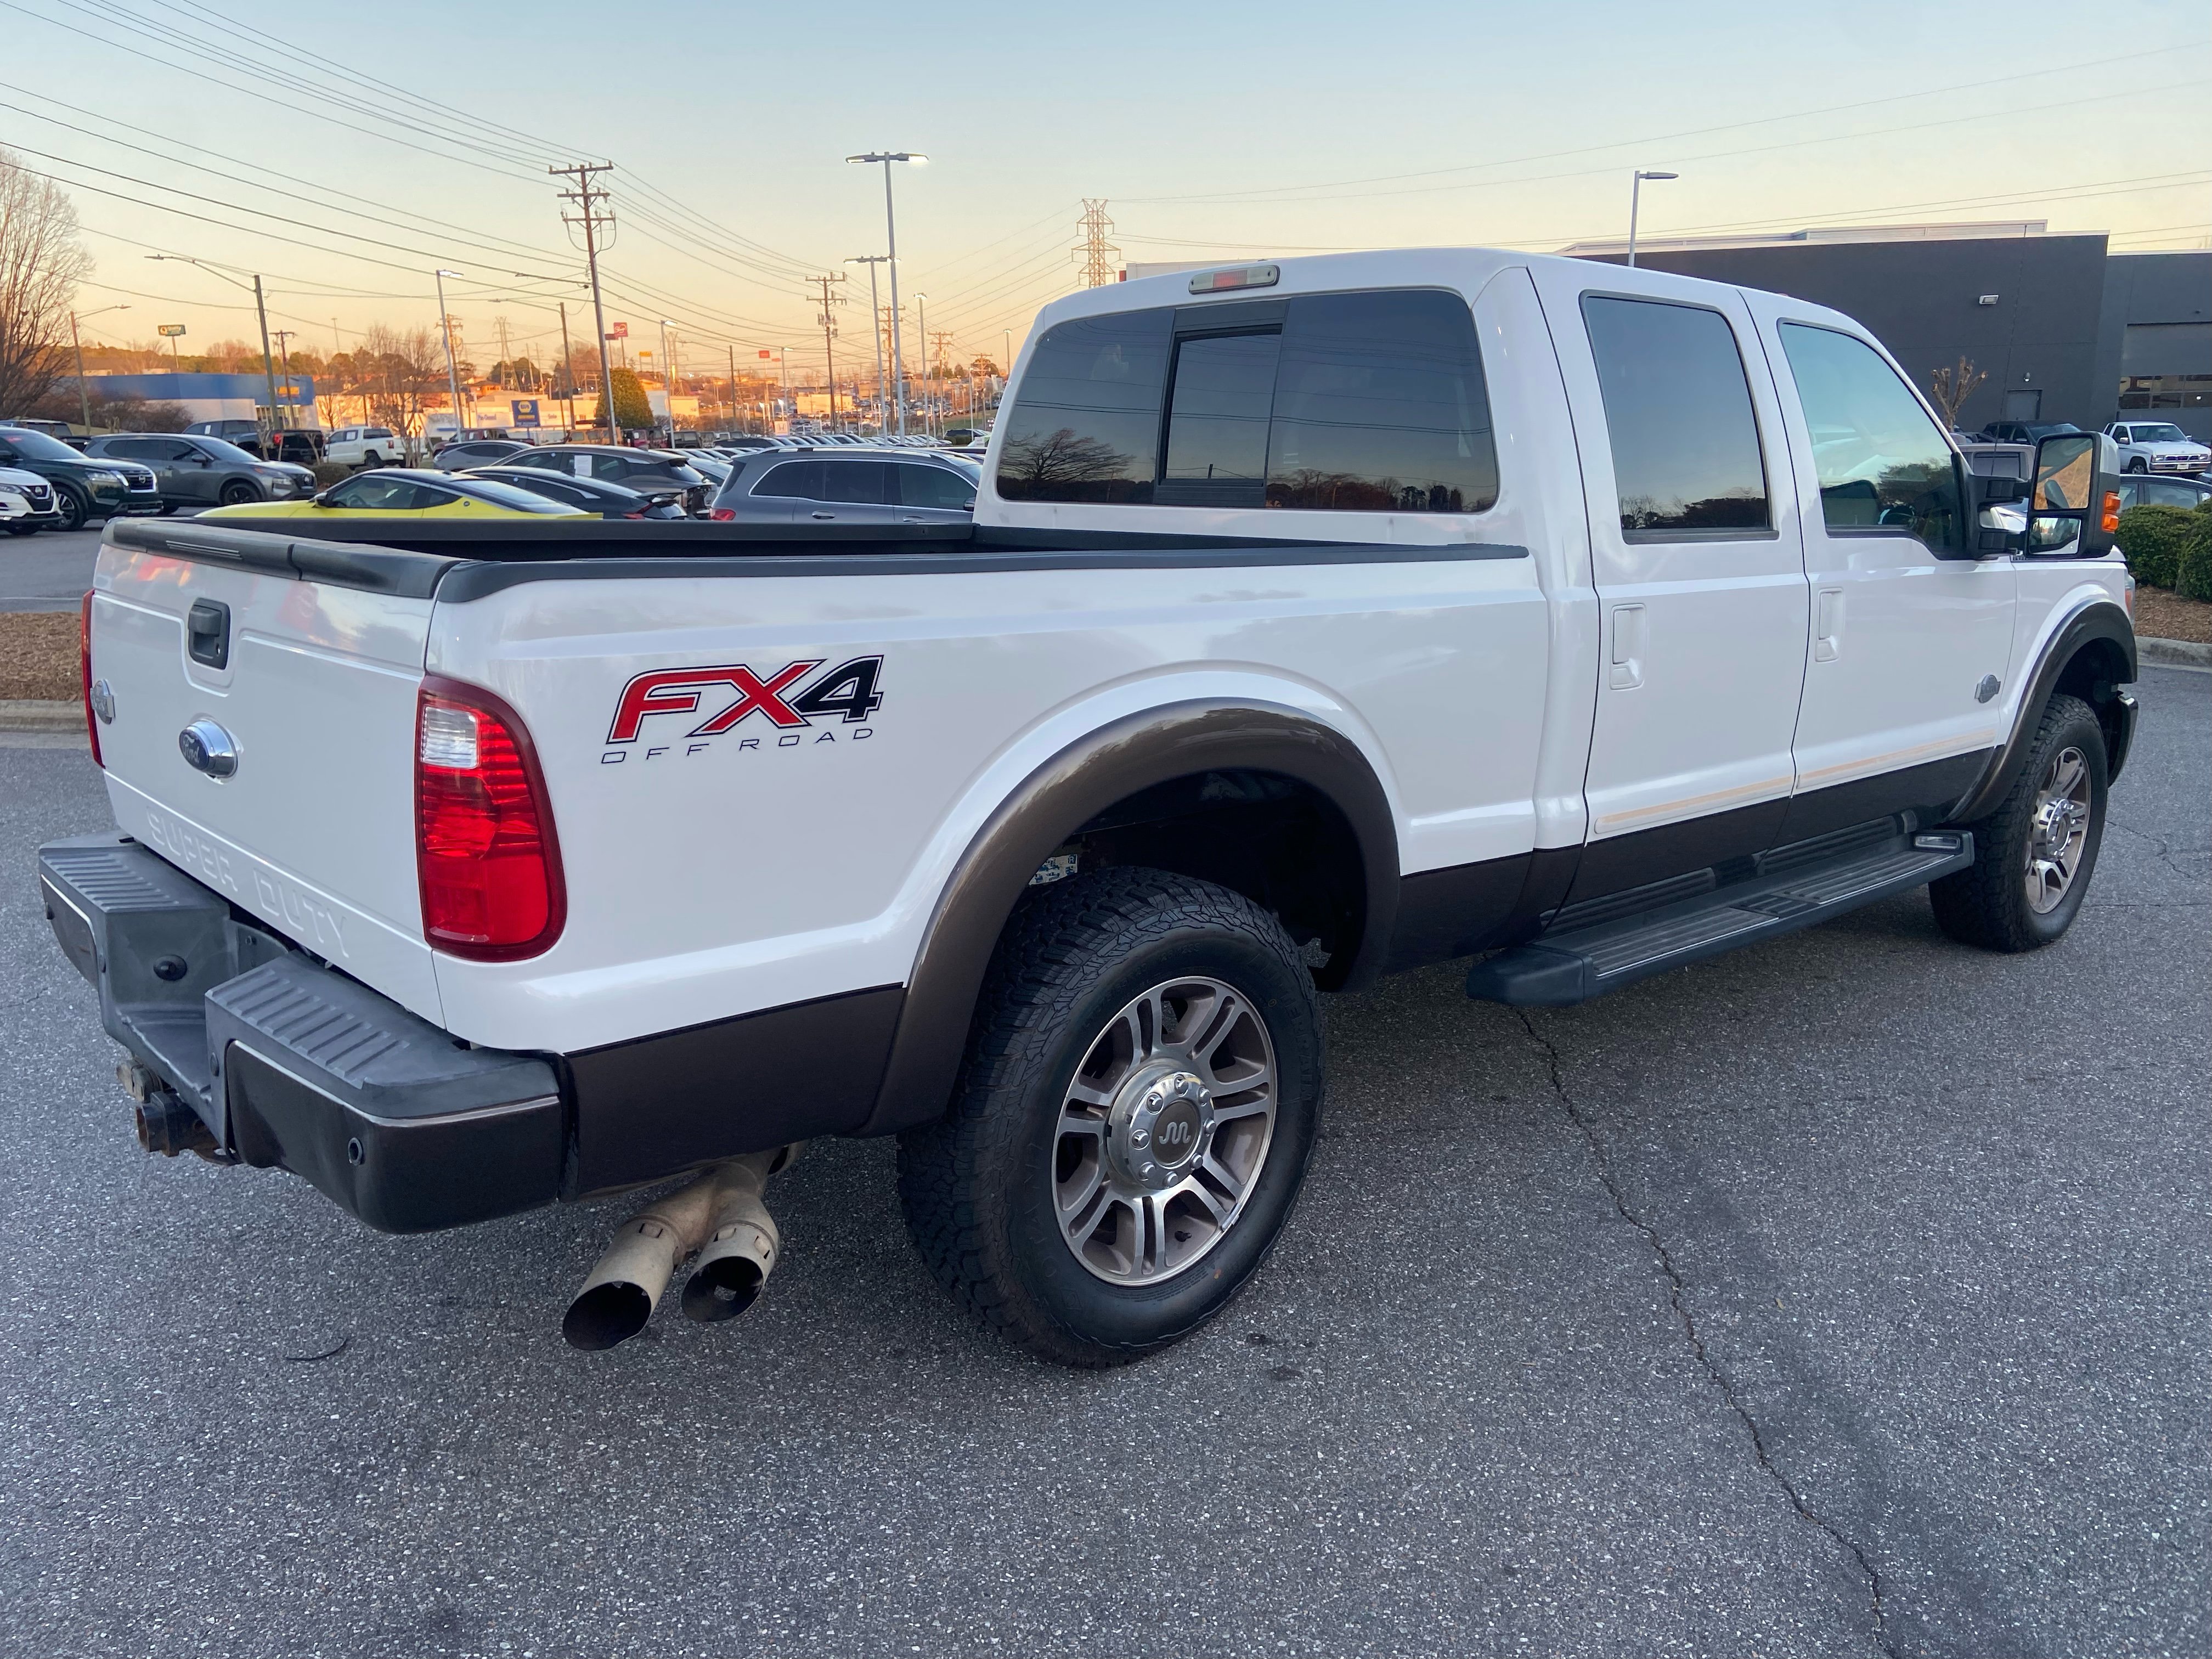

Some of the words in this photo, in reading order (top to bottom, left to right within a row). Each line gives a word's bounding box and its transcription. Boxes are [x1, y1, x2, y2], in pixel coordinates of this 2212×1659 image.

[605, 654, 885, 744] FX4
[182, 734, 200, 764] Ford
[146, 806, 239, 892] SUPER
[253, 867, 349, 959] DUTY
